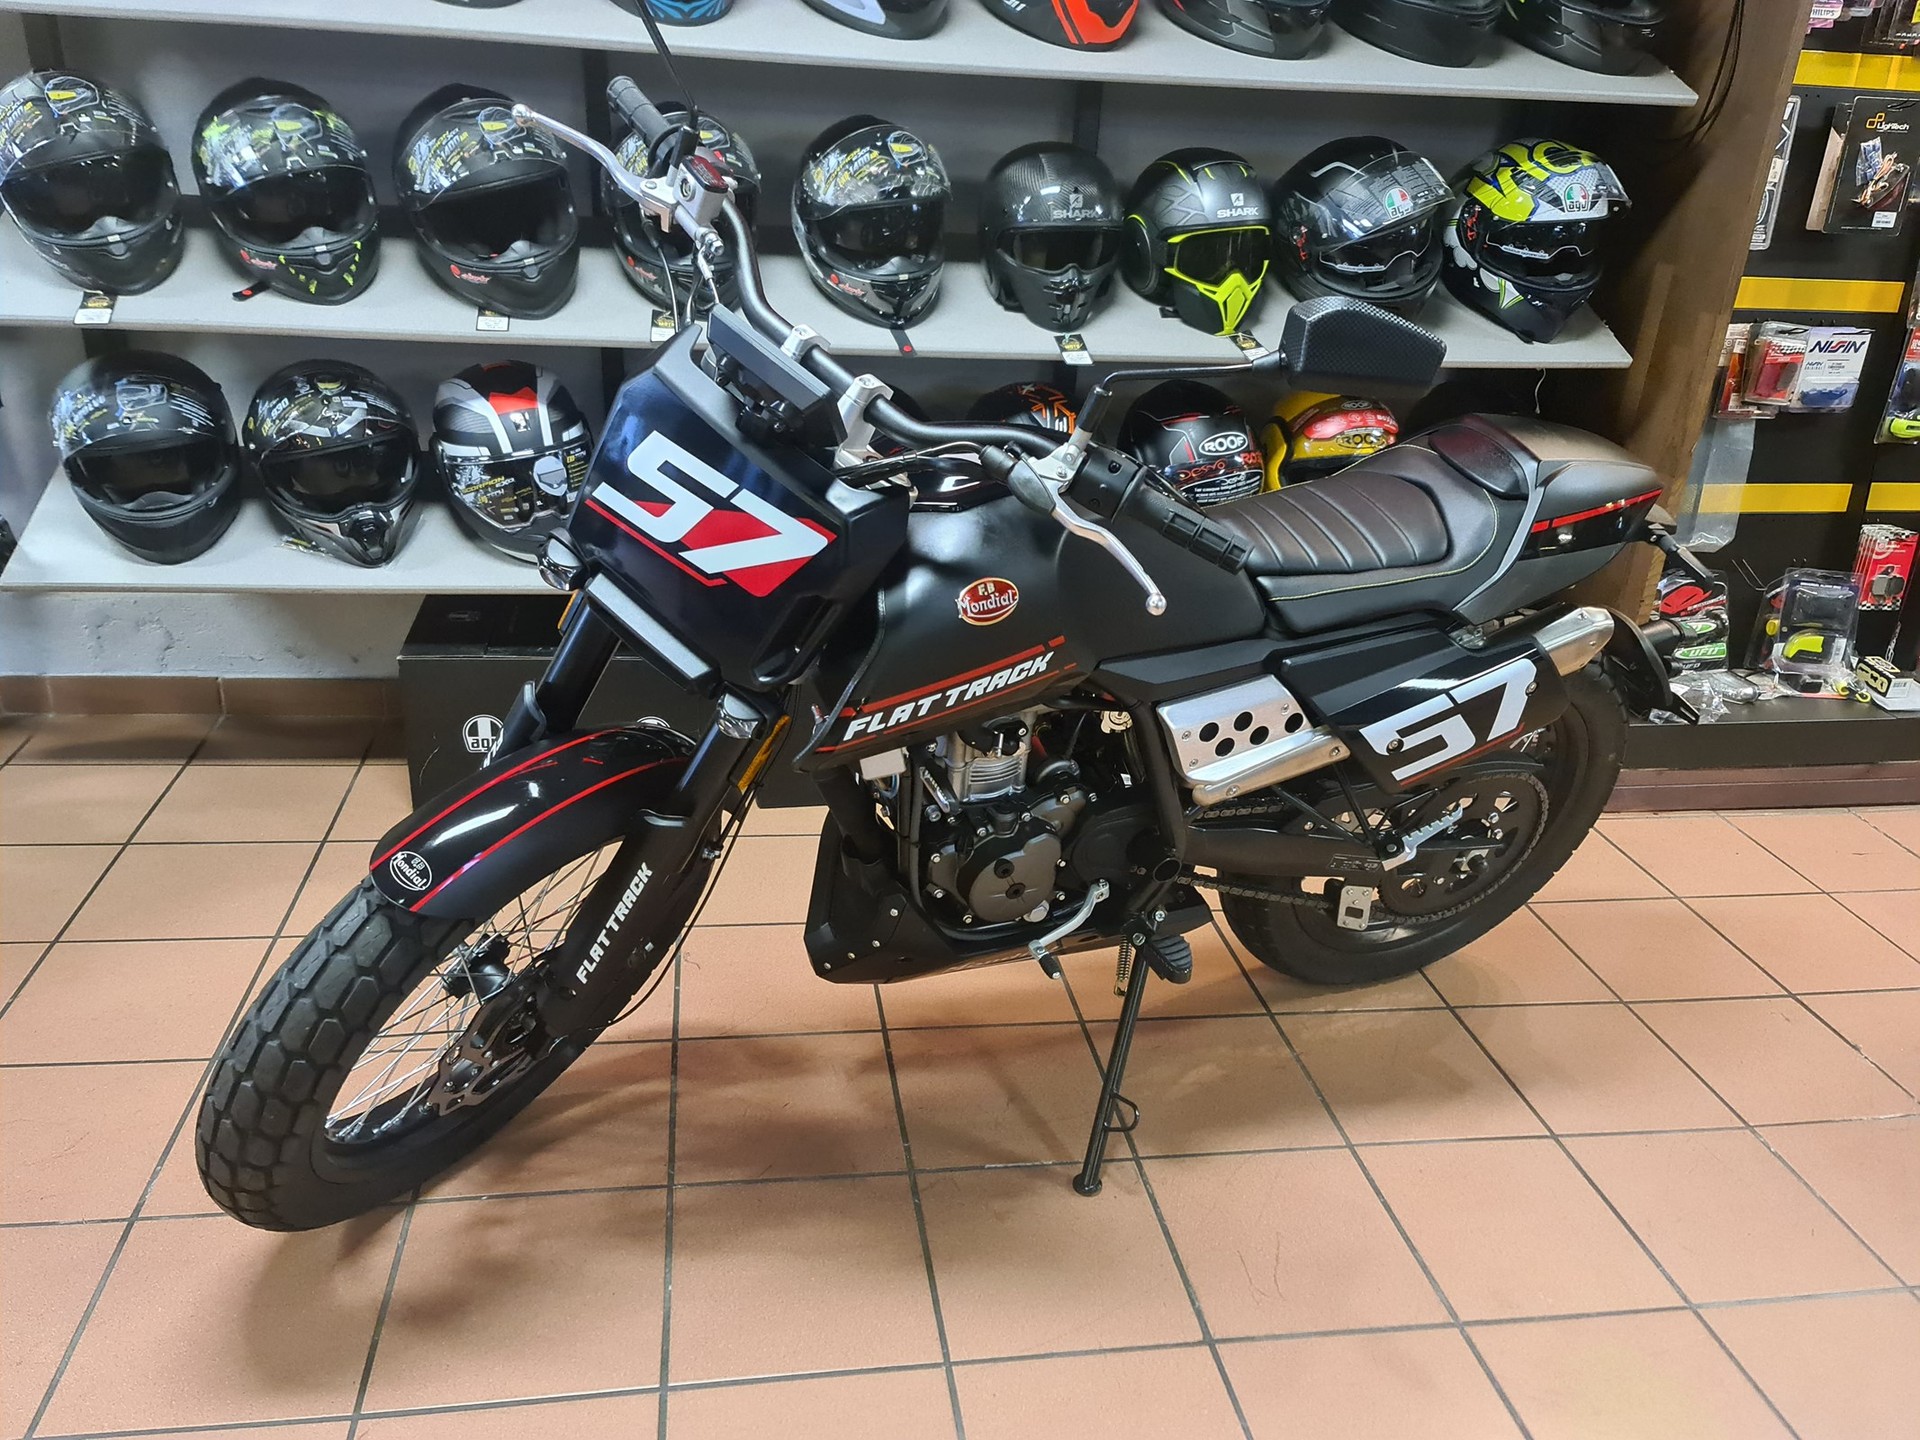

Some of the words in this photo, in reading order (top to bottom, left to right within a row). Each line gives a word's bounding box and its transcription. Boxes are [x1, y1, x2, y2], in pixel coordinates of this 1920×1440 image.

[1053, 210, 1098, 218] SHARK
[1217, 207, 1259, 218] SHARK
[1204, 436, 1244, 451] ROOF
[592, 430, 829, 575] 57
[955, 589, 1014, 618] Mondial
[1688, 646, 1719, 658] UFO
[843, 693, 942, 741] FLAT
[945, 651, 1055, 708] TRACK
[1358, 658, 1537, 781] 57
[392, 853, 428, 888] Mondial
[576, 928, 611, 985] FLAT
[605, 861, 653, 932] TRACK
